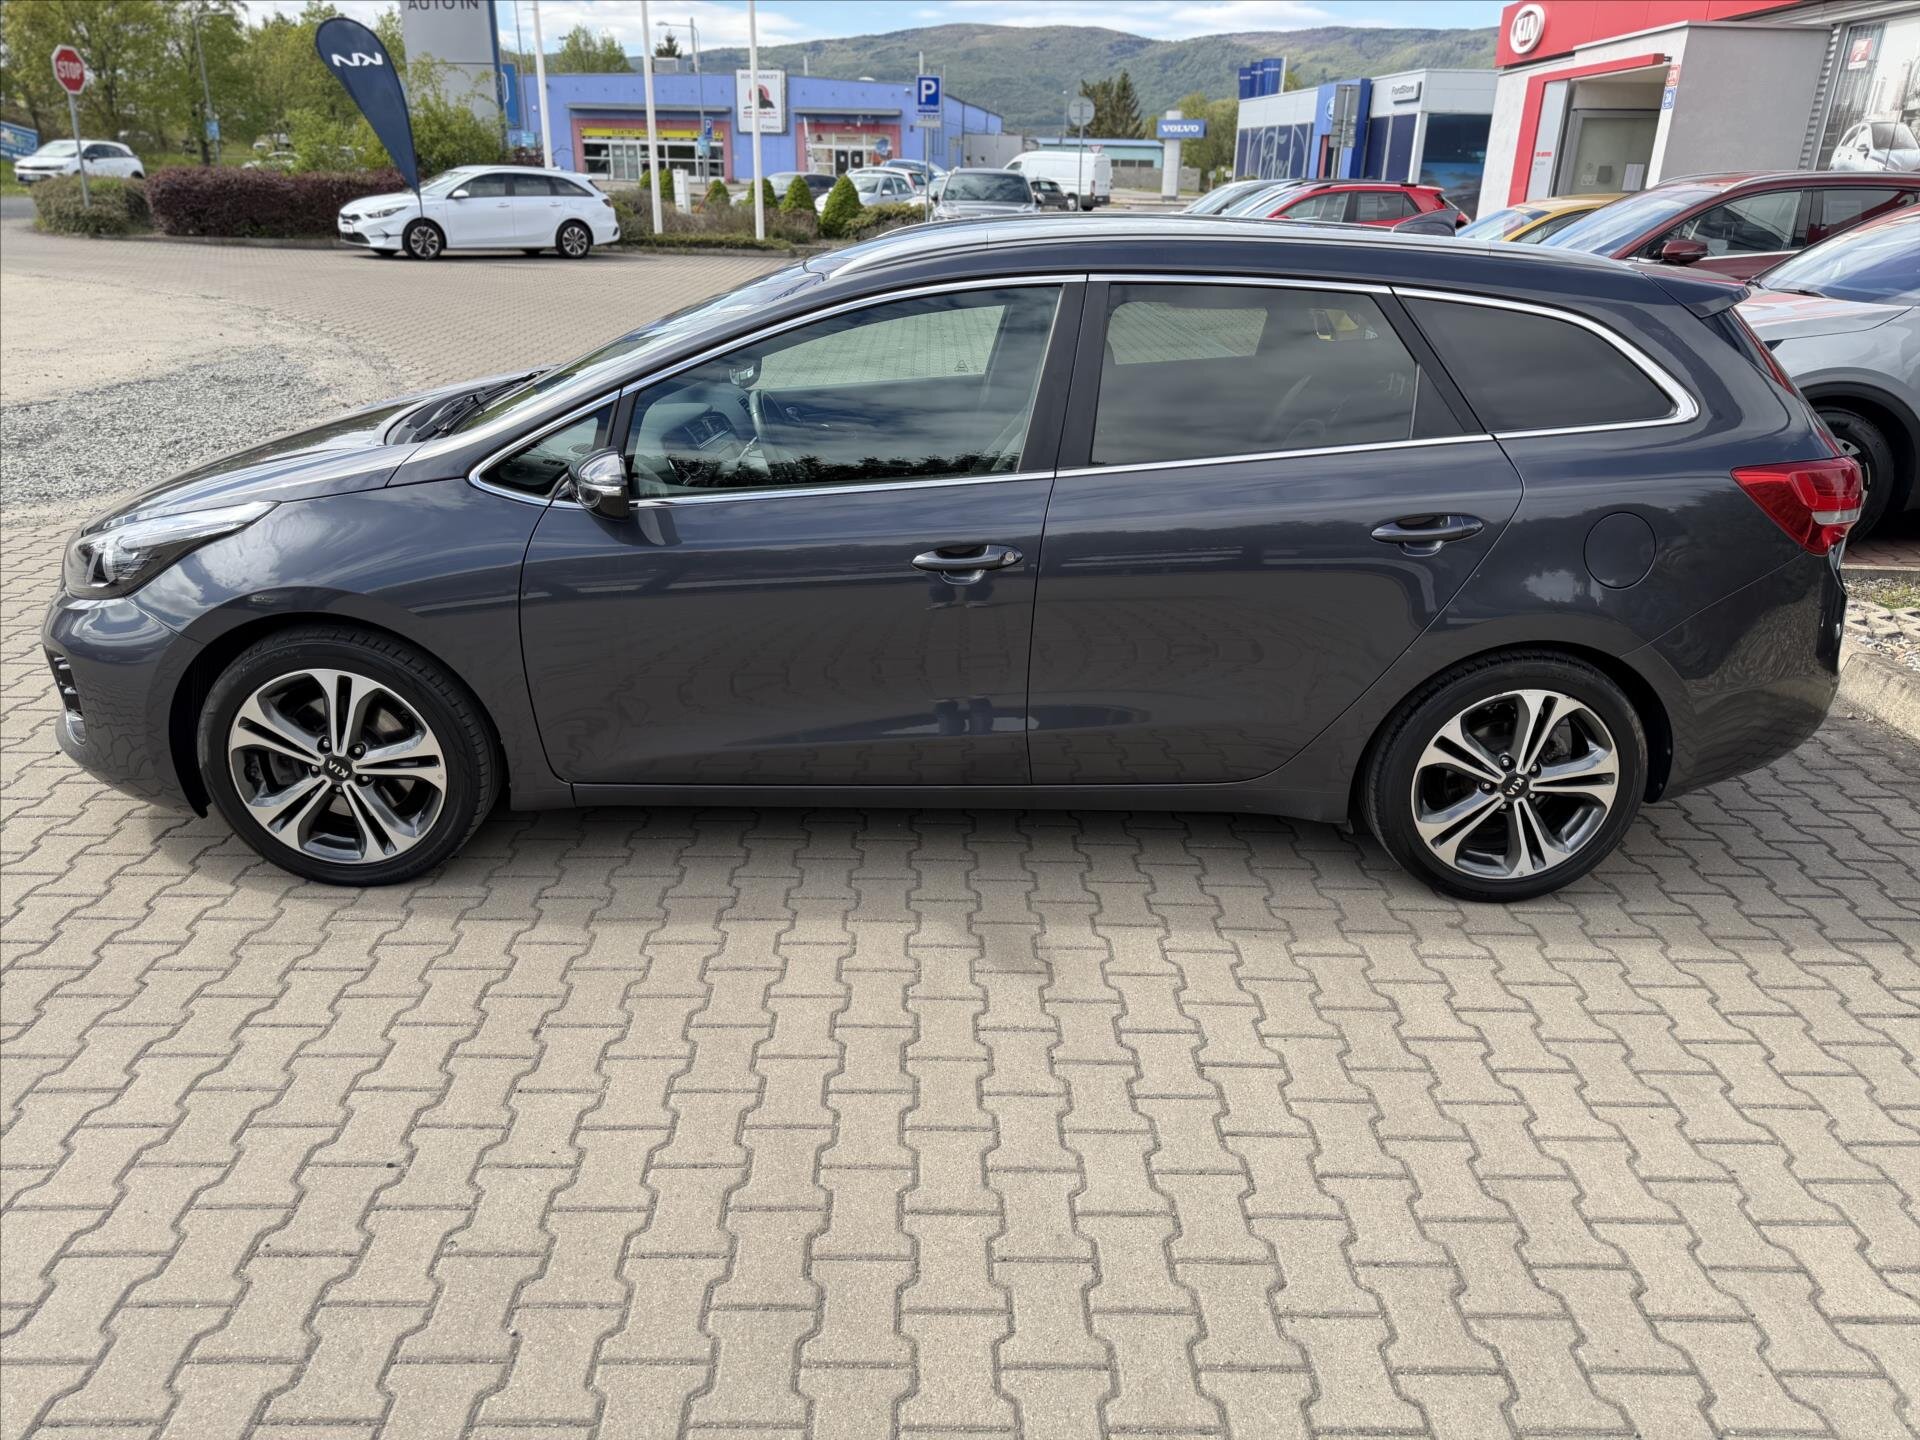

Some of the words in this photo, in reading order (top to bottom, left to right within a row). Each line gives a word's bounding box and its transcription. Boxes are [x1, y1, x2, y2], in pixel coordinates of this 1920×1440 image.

[57, 60, 82, 79] STOP
[921, 80, 936, 103] P
[1392, 85, 1414, 95] FordStore
[1161, 124, 1199, 133] VOLVO
[329, 761, 349, 778] KIA
[1506, 778, 1524, 795] KIA
